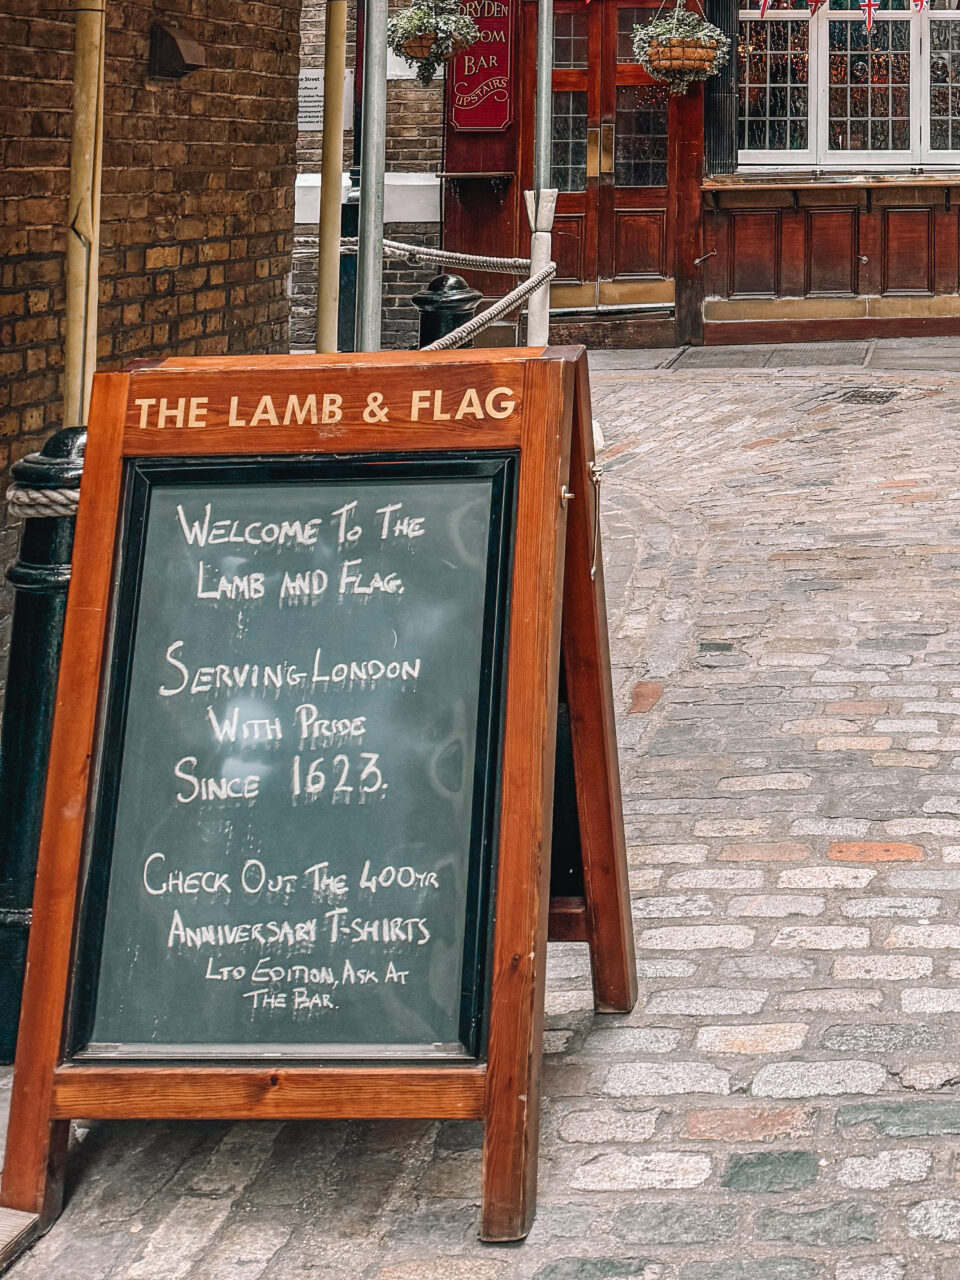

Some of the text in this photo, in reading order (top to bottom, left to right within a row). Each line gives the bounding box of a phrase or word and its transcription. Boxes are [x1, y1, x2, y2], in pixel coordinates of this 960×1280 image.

[458, 0, 508, 17] DRYDEN
[473, 30, 506, 42] OM
[464, 56, 498, 75] BAR
[455, 79, 508, 106] UPSTAIRS
[135, 386, 516, 429] THE LAMB & FLAG
[176, 504, 322, 547] WELCOME
[376, 502, 425, 539] THE
[197, 560, 265, 599] LAMB
[280, 569, 328, 599] AND
[159, 640, 421, 697] SERVING LONDON
[206, 703, 366, 743] WITH PRIDE
[174, 756, 260, 804] SINCE
[143, 853, 232, 895] CHECK
[241, 859, 298, 894] OUT
[304, 861, 349, 894] THE
[167, 907, 432, 948] ANNIVERSARY T-SHIRTS
[342, 960, 379, 984] ASK
[385, 961, 409, 985] AT
[243, 989, 287, 1010] THE
